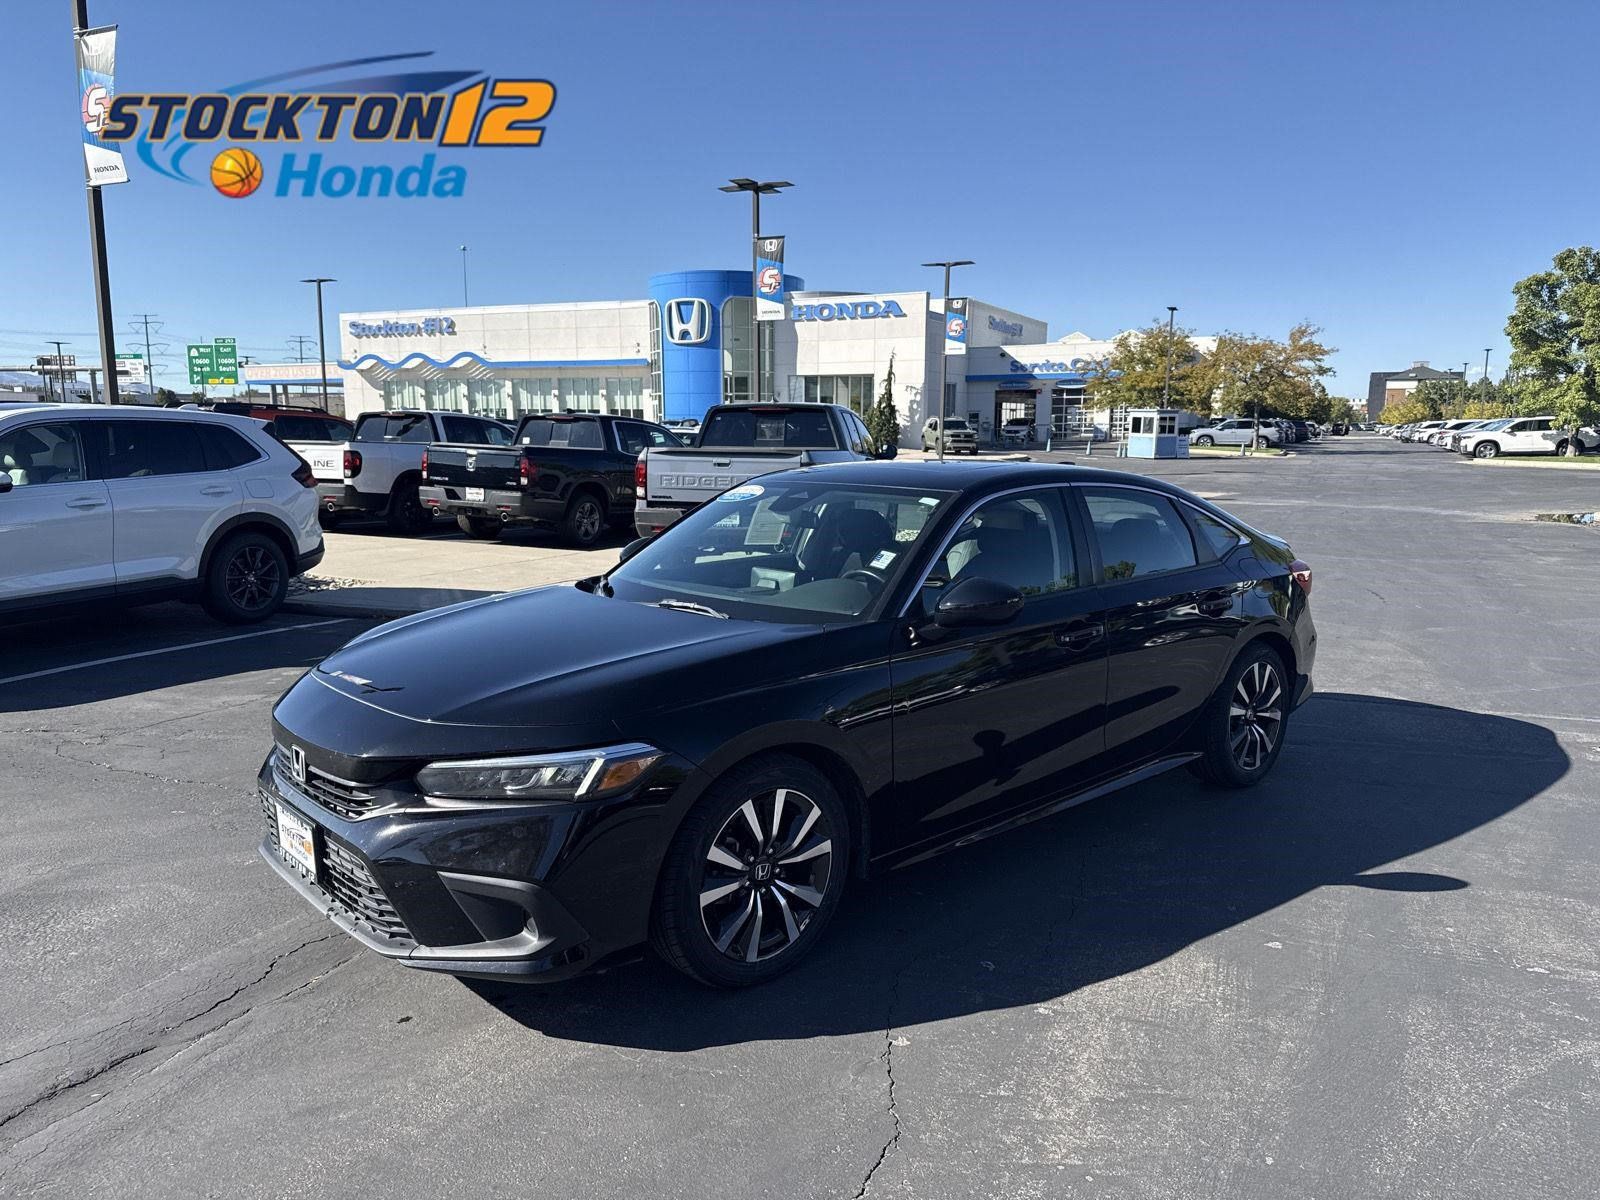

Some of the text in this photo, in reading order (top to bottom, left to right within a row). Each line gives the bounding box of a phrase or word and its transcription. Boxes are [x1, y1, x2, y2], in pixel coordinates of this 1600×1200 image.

[94, 164, 120, 174] HONDA
[792, 300, 907, 322] HONDA
[349, 316, 458, 339] Stockton #12
[661, 475, 737, 488] RIDGEL
